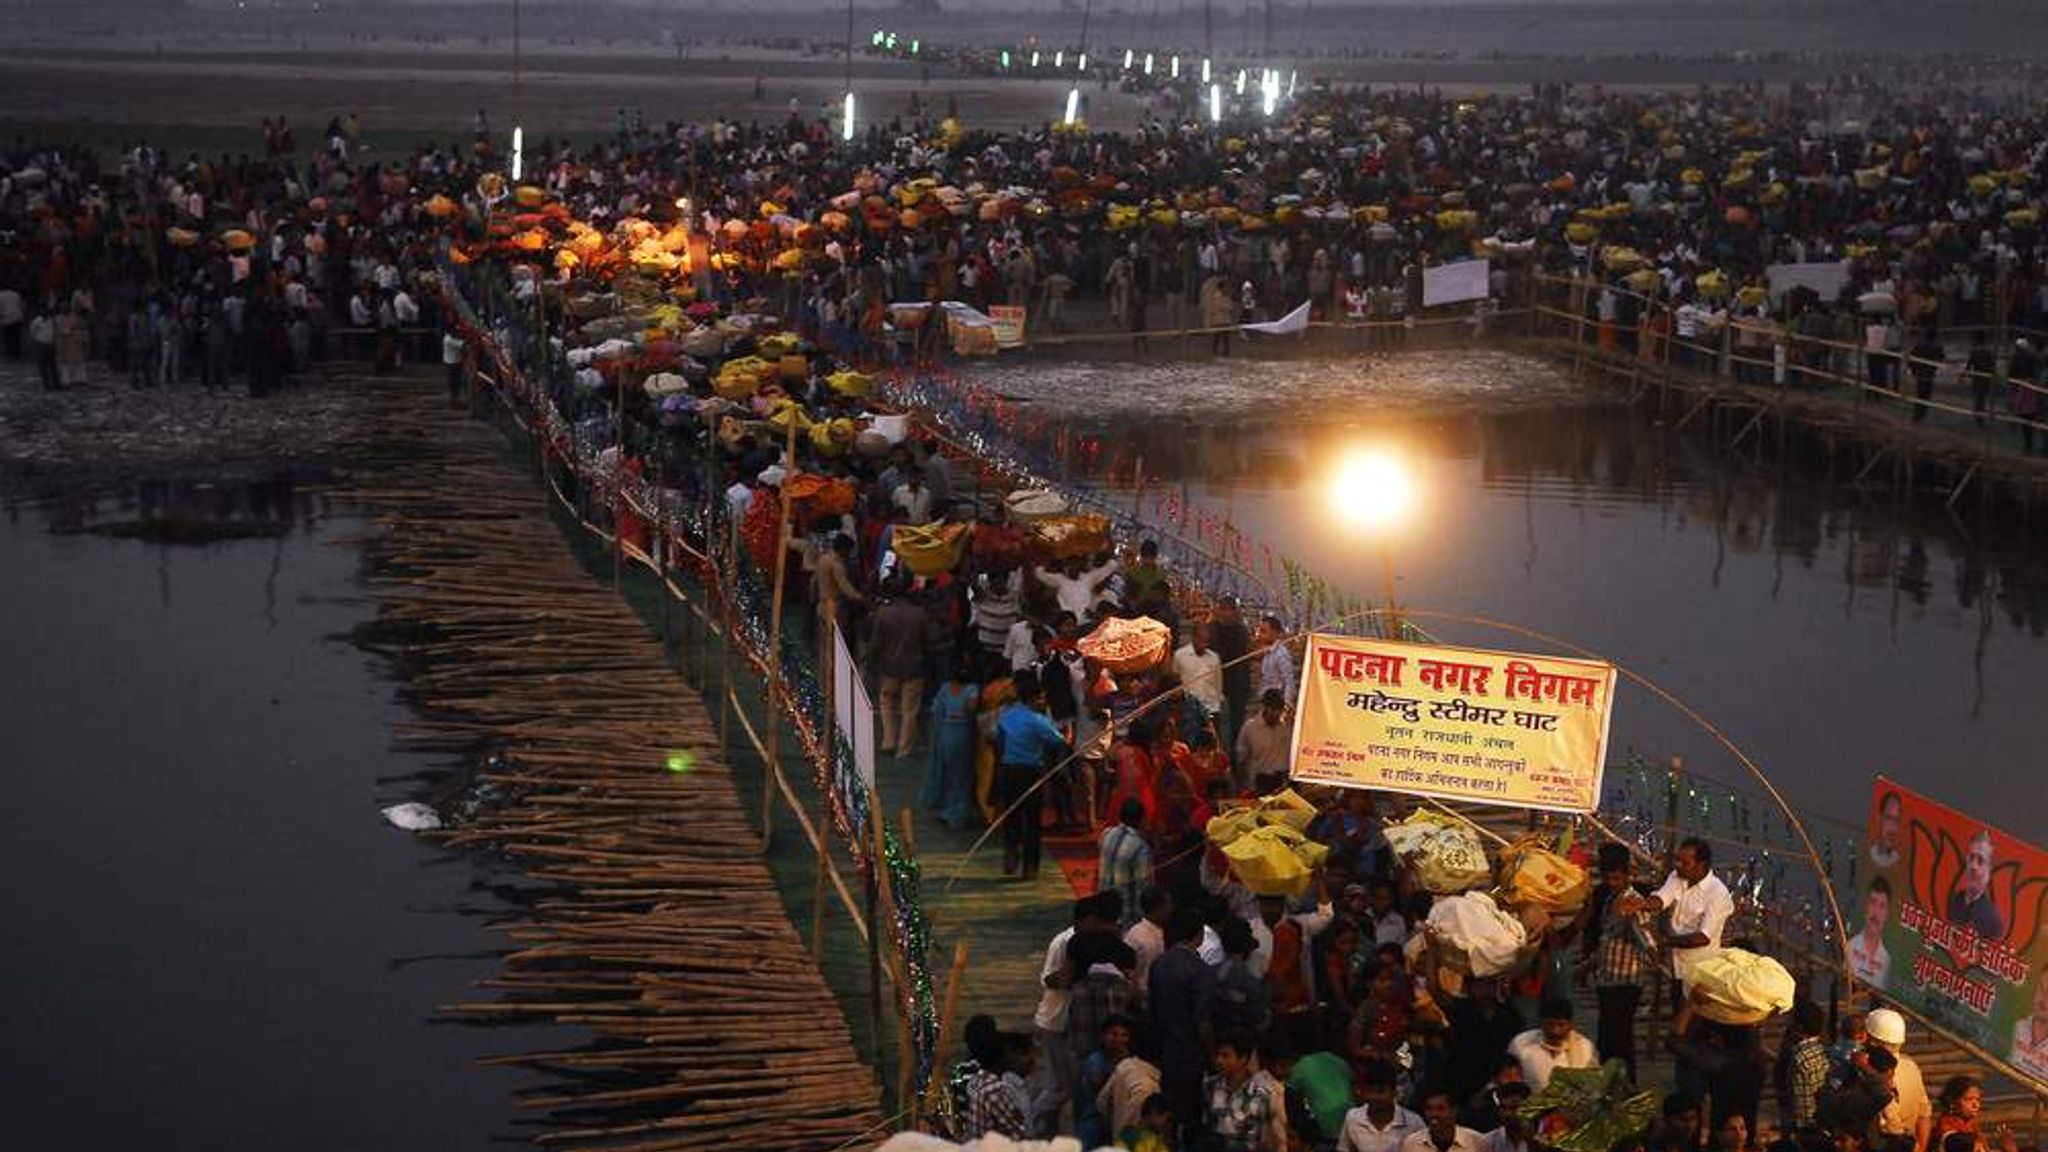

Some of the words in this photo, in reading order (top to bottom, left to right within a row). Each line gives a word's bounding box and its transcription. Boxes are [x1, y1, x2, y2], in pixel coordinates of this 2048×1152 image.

[1318, 646, 1407, 687] पटना
[1418, 657, 1494, 697] नगर
[1504, 661, 1601, 707] निगम
[1428, 698, 1505, 726] स्टीमर
[1513, 709, 1560, 732] घाट
[1422, 728, 1473, 745] राजधानी
